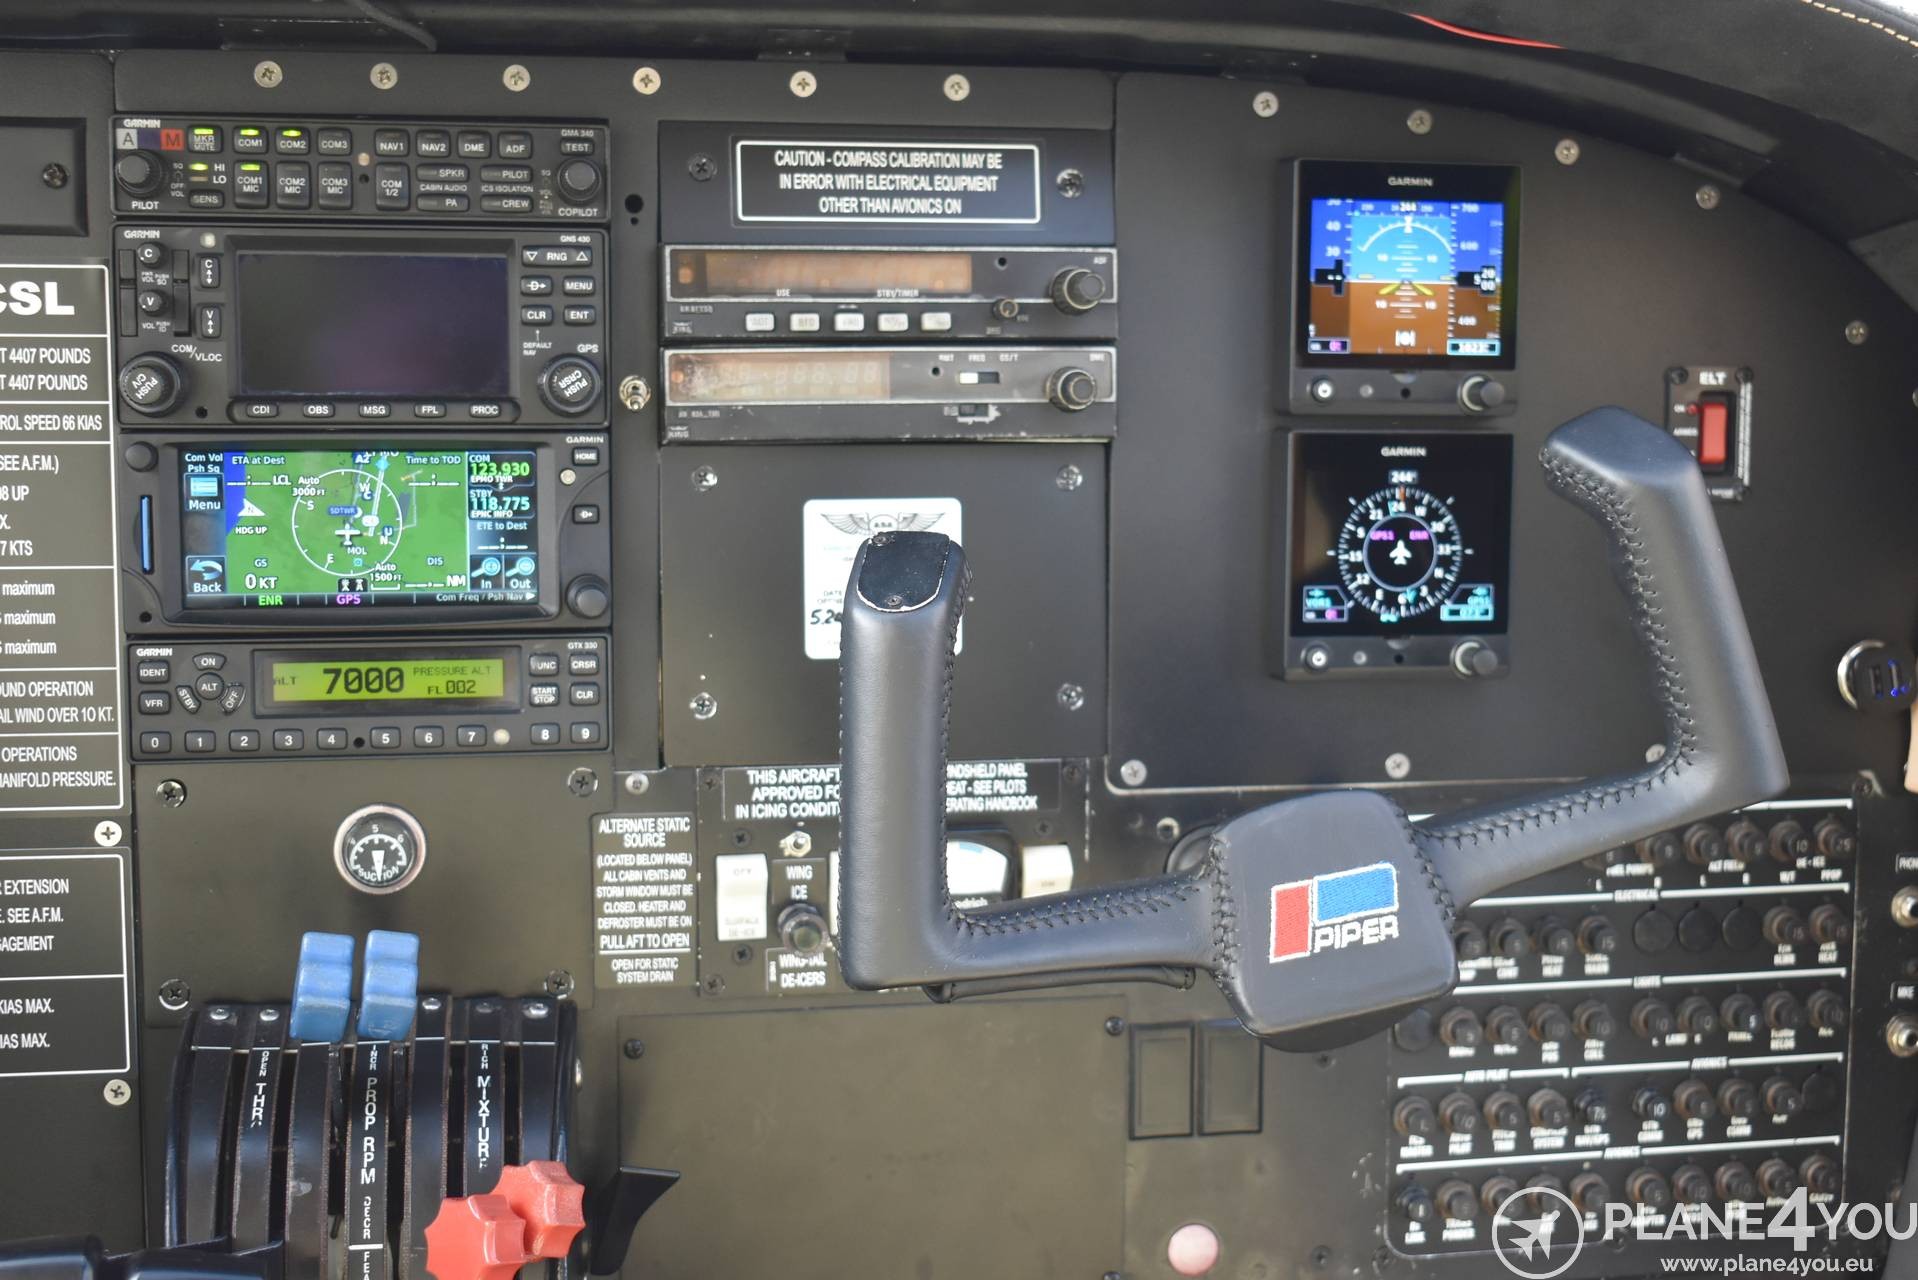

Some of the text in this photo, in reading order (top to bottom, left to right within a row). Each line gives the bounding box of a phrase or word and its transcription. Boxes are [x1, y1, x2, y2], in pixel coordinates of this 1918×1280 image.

[506, 145, 525, 153] ADF
[774, 150, 1002, 169] CAUTION COMPASS CALIBRATION MAY BE
[780, 174, 998, 191] IN ERROR WITH ELECTRICAL EQUIPMENT
[1388, 177, 1432, 186] GARMIN
[132, 201, 159, 210] PILOT
[502, 200, 529, 208] CREW
[819, 198, 961, 213] OTHER THAN AVIONICS ON
[558, 208, 598, 216] COPILOT
[547, 253, 567, 261] RNG
[9, 349, 36, 363] 4407
[39, 348, 91, 364] POUNDS
[9, 375, 34, 390] 4407
[38, 375, 88, 390] POUNDS
[1700, 371, 1726, 385] ELT
[253, 405, 270, 416] CDI
[308, 405, 329, 416] OBS
[364, 405, 386, 416] MSG
[422, 405, 439, 416] FPL
[471, 405, 499, 416] PROC
[25, 415, 60, 430] SPEED
[63, 416, 75, 430] 66
[78, 415, 102, 430] KIAS
[185, 453, 223, 462] Com Vol
[1381, 447, 1426, 456] GARMIN
[232, 456, 250, 464] ETA
[263, 456, 285, 464] Dest
[406, 456, 461, 464] Time to TOD
[188, 464, 204, 473] Psh
[471, 463, 530, 476] 123.930
[12, 486, 29, 500] UP
[189, 501, 221, 510] Menu
[471, 497, 530, 510] 118.775
[477, 522, 527, 530] ETE to Dest
[10, 540, 33, 555] KTS
[3, 581, 54, 595] maximum
[194, 583, 221, 593] Back
[510, 580, 530, 588] Out
[258, 595, 283, 605] ENR
[336, 594, 361, 604] GPS
[436, 593, 457, 601] Com
[459, 593, 479, 602] Freq
[5, 611, 55, 625] maximum
[5, 640, 56, 654] maximum
[137, 648, 172, 656] GARMIN
[201, 658, 215, 666] ON
[572, 660, 596, 669] CRSR
[413, 667, 491, 676] PRESSURE ALT
[201, 683, 218, 691] ALT
[323, 667, 404, 694] 7000
[446, 680, 476, 694] 002
[29, 681, 93, 696] OPERATION
[576, 691, 593, 699] CLR
[145, 699, 163, 707] VFR
[15, 707, 114, 723] WIND OVER 10 KT.
[2, 747, 77, 762] OPERATIONS
[53, 771, 116, 787] PRESSURE.
[748, 768, 839, 784] THIS AIRCRAFT
[752, 786, 822, 800] APPROVED
[973, 780, 1026, 794] SEE PILOTS
[985, 796, 1037, 811] HANDBOOK
[736, 803, 787, 818] IN ICING
[600, 818, 690, 833] ALTERNATE STATIC
[624, 834, 665, 847] SOURCE
[597, 853, 692, 866] (LOCATED BELOW PANEL)
[359, 866, 399, 881] SUCION
[604, 869, 686, 882] ALL CABIN VENTS AND
[787, 867, 812, 879] WING
[5, 879, 69, 894] EXTENSION
[596, 885, 693, 897] STORM WINDOW MUST BE
[791, 886, 807, 899] ICE
[639, 901, 669, 912] HEATER
[670, 901, 686, 912] AND
[7, 907, 64, 923] SEE A.F.M.
[598, 916, 692, 929] DEFROSTER MUST BE ON
[1313, 915, 1399, 952] PIPER
[600, 933, 689, 949] PULL AFT TO OPEN
[612, 958, 678, 970] OPEN FOR STATIC
[617, 971, 674, 983] SYSTEM DRAIN
[781, 971, 825, 988] DE-ICERS
[26, 998, 55, 1013] MAX.
[22, 1033, 50, 1048] MAX.
[369, 1045, 378, 1070] INCR
[362, 1077, 377, 1184] PROP RPM
